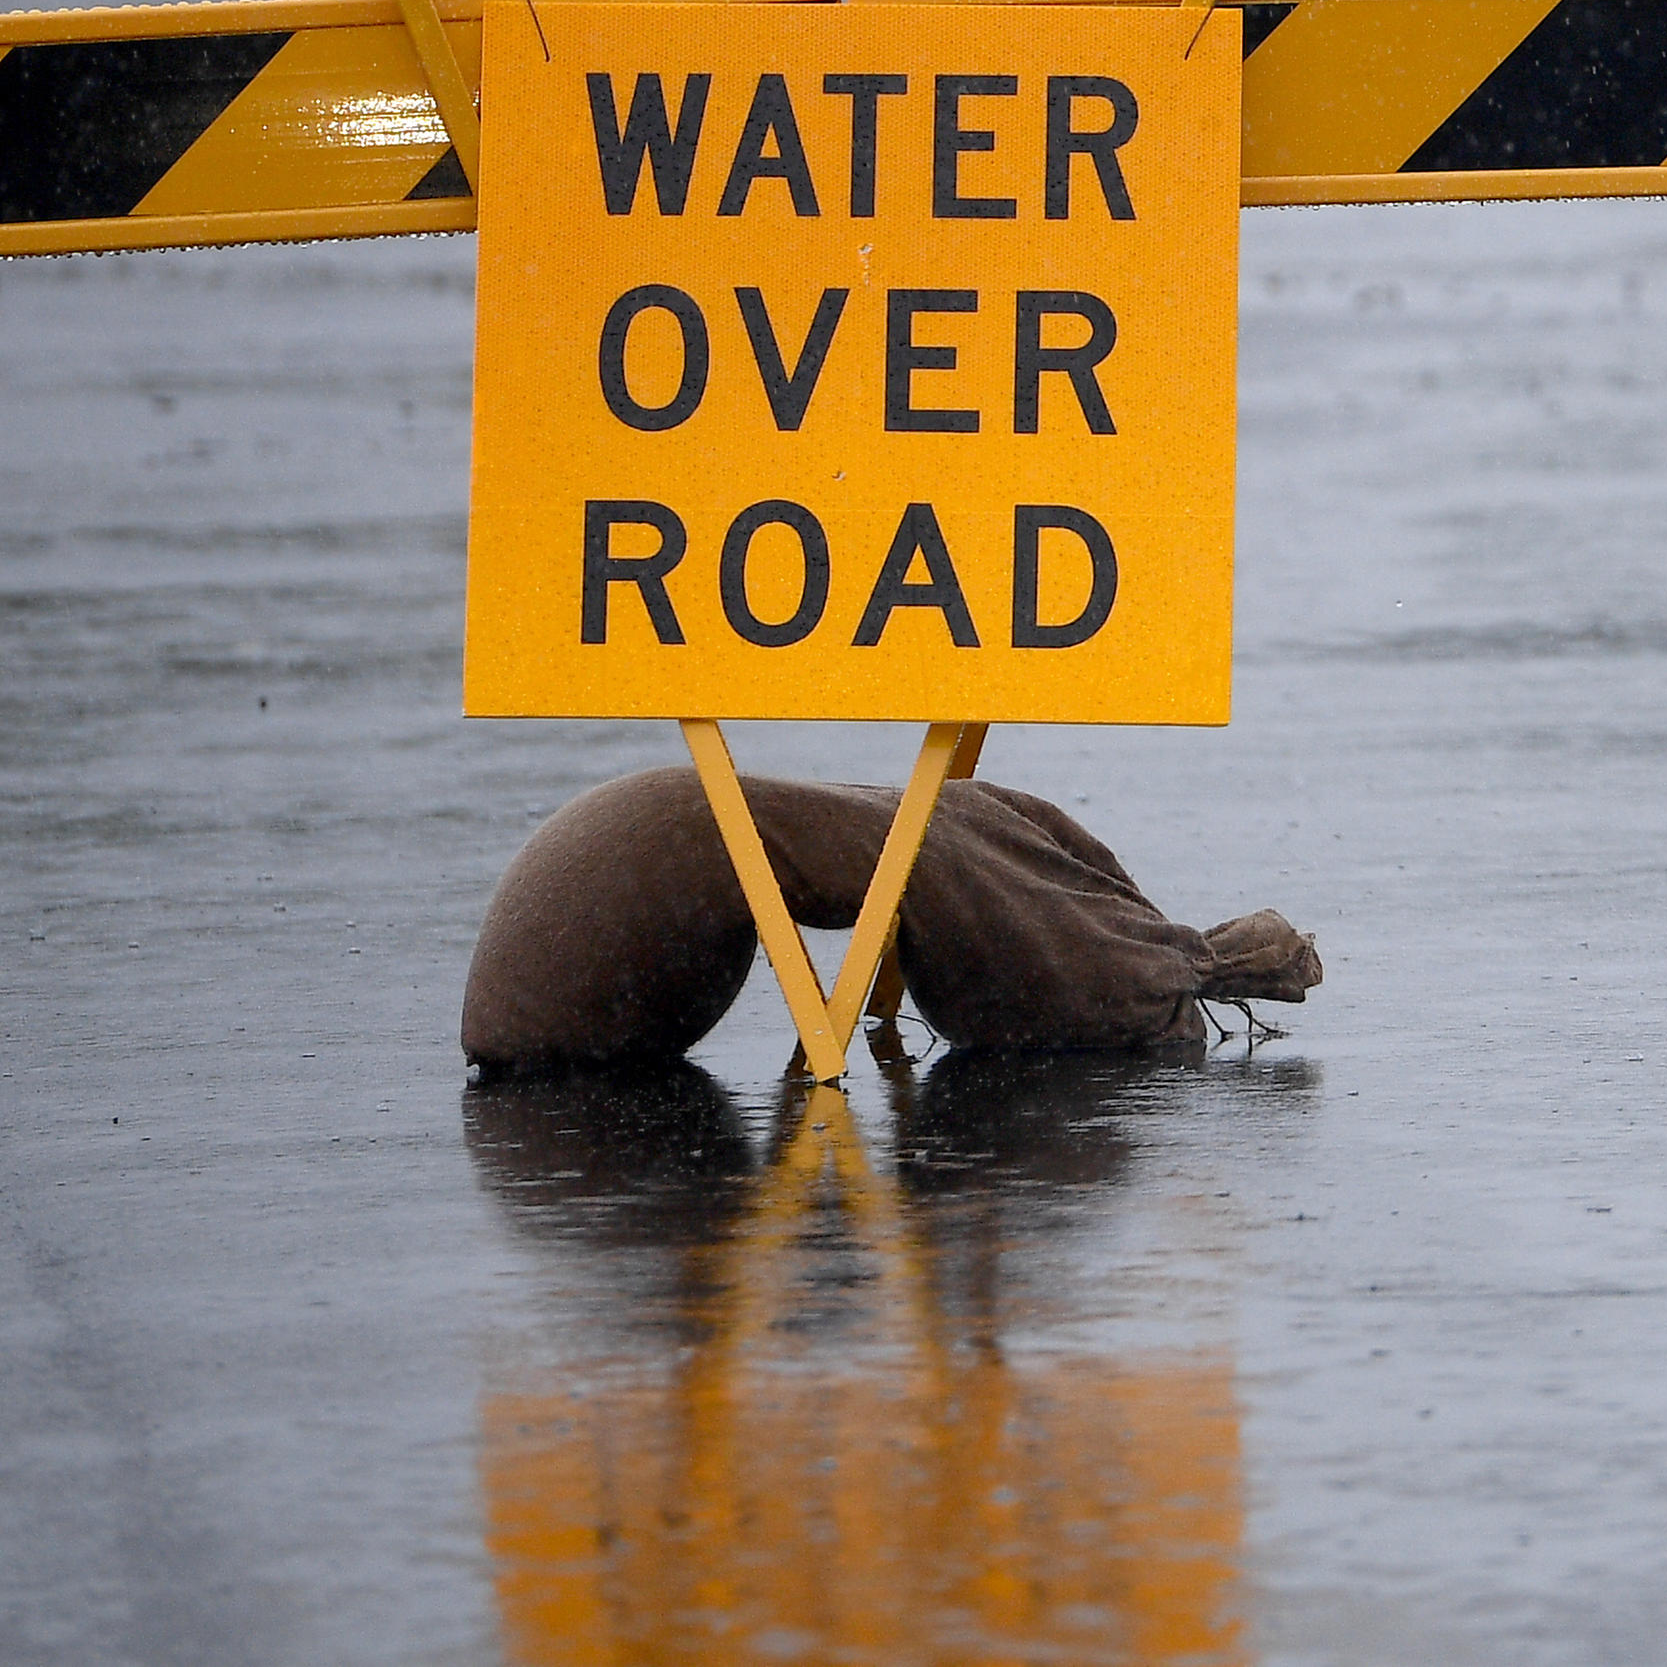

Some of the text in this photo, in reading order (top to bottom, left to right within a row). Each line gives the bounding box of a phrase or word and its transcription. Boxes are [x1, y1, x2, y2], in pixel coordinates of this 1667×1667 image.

[586, 73, 1138, 220] WATER
[599, 284, 1117, 435] OVER
[581, 500, 1117, 648] ROAD
